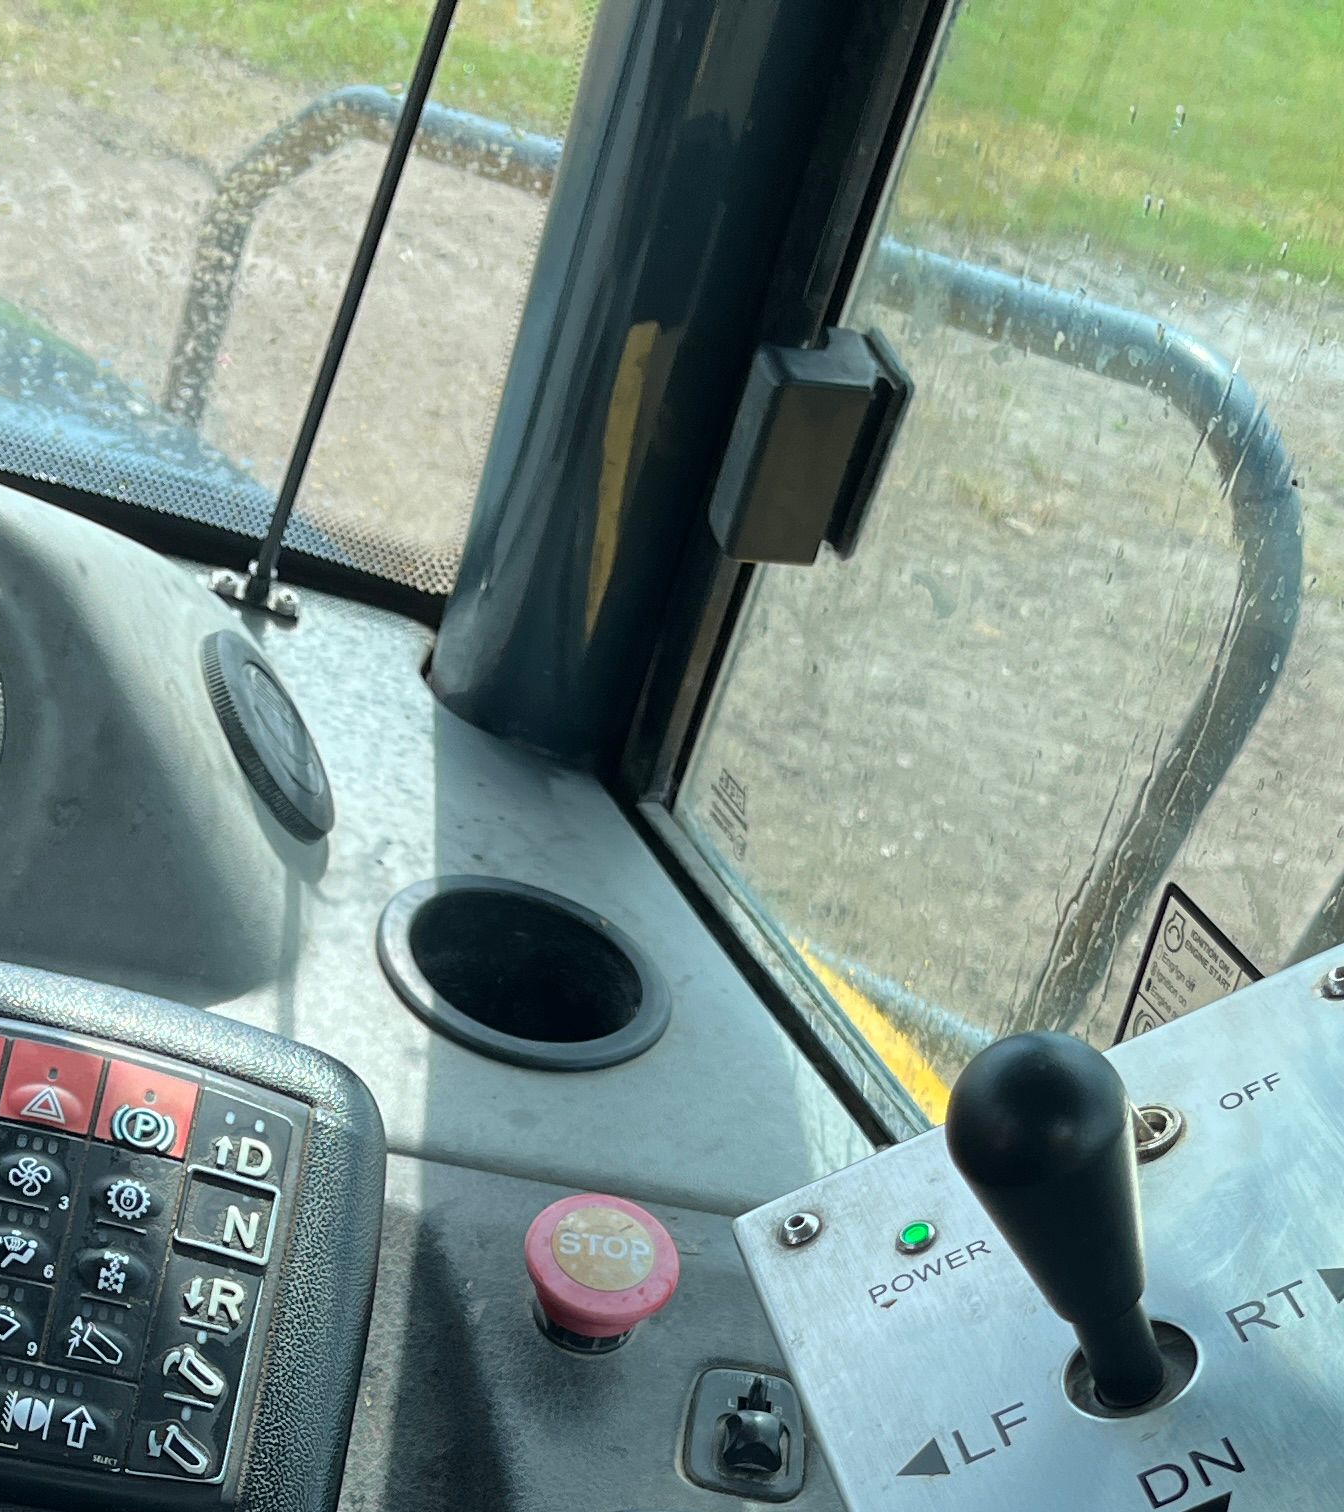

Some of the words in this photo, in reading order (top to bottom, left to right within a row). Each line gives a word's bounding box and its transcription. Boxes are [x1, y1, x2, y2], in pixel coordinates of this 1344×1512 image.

[1208, 964, 1231, 991] START
[1218, 1072, 1282, 1111] OFF
[235, 1136, 273, 1178] D
[57, 1195, 70, 1211] 3
[222, 1204, 260, 1250] N
[558, 1231, 651, 1268] STOP
[42, 1264, 56, 1280] 6
[867, 1239, 992, 1305] POWER
[206, 1277, 246, 1323] R
[1225, 1279, 1306, 1344] RT
[25, 1340, 39, 1358] 9
[953, 1401, 1029, 1466] LF
[1137, 1436, 1247, 1509] DN
